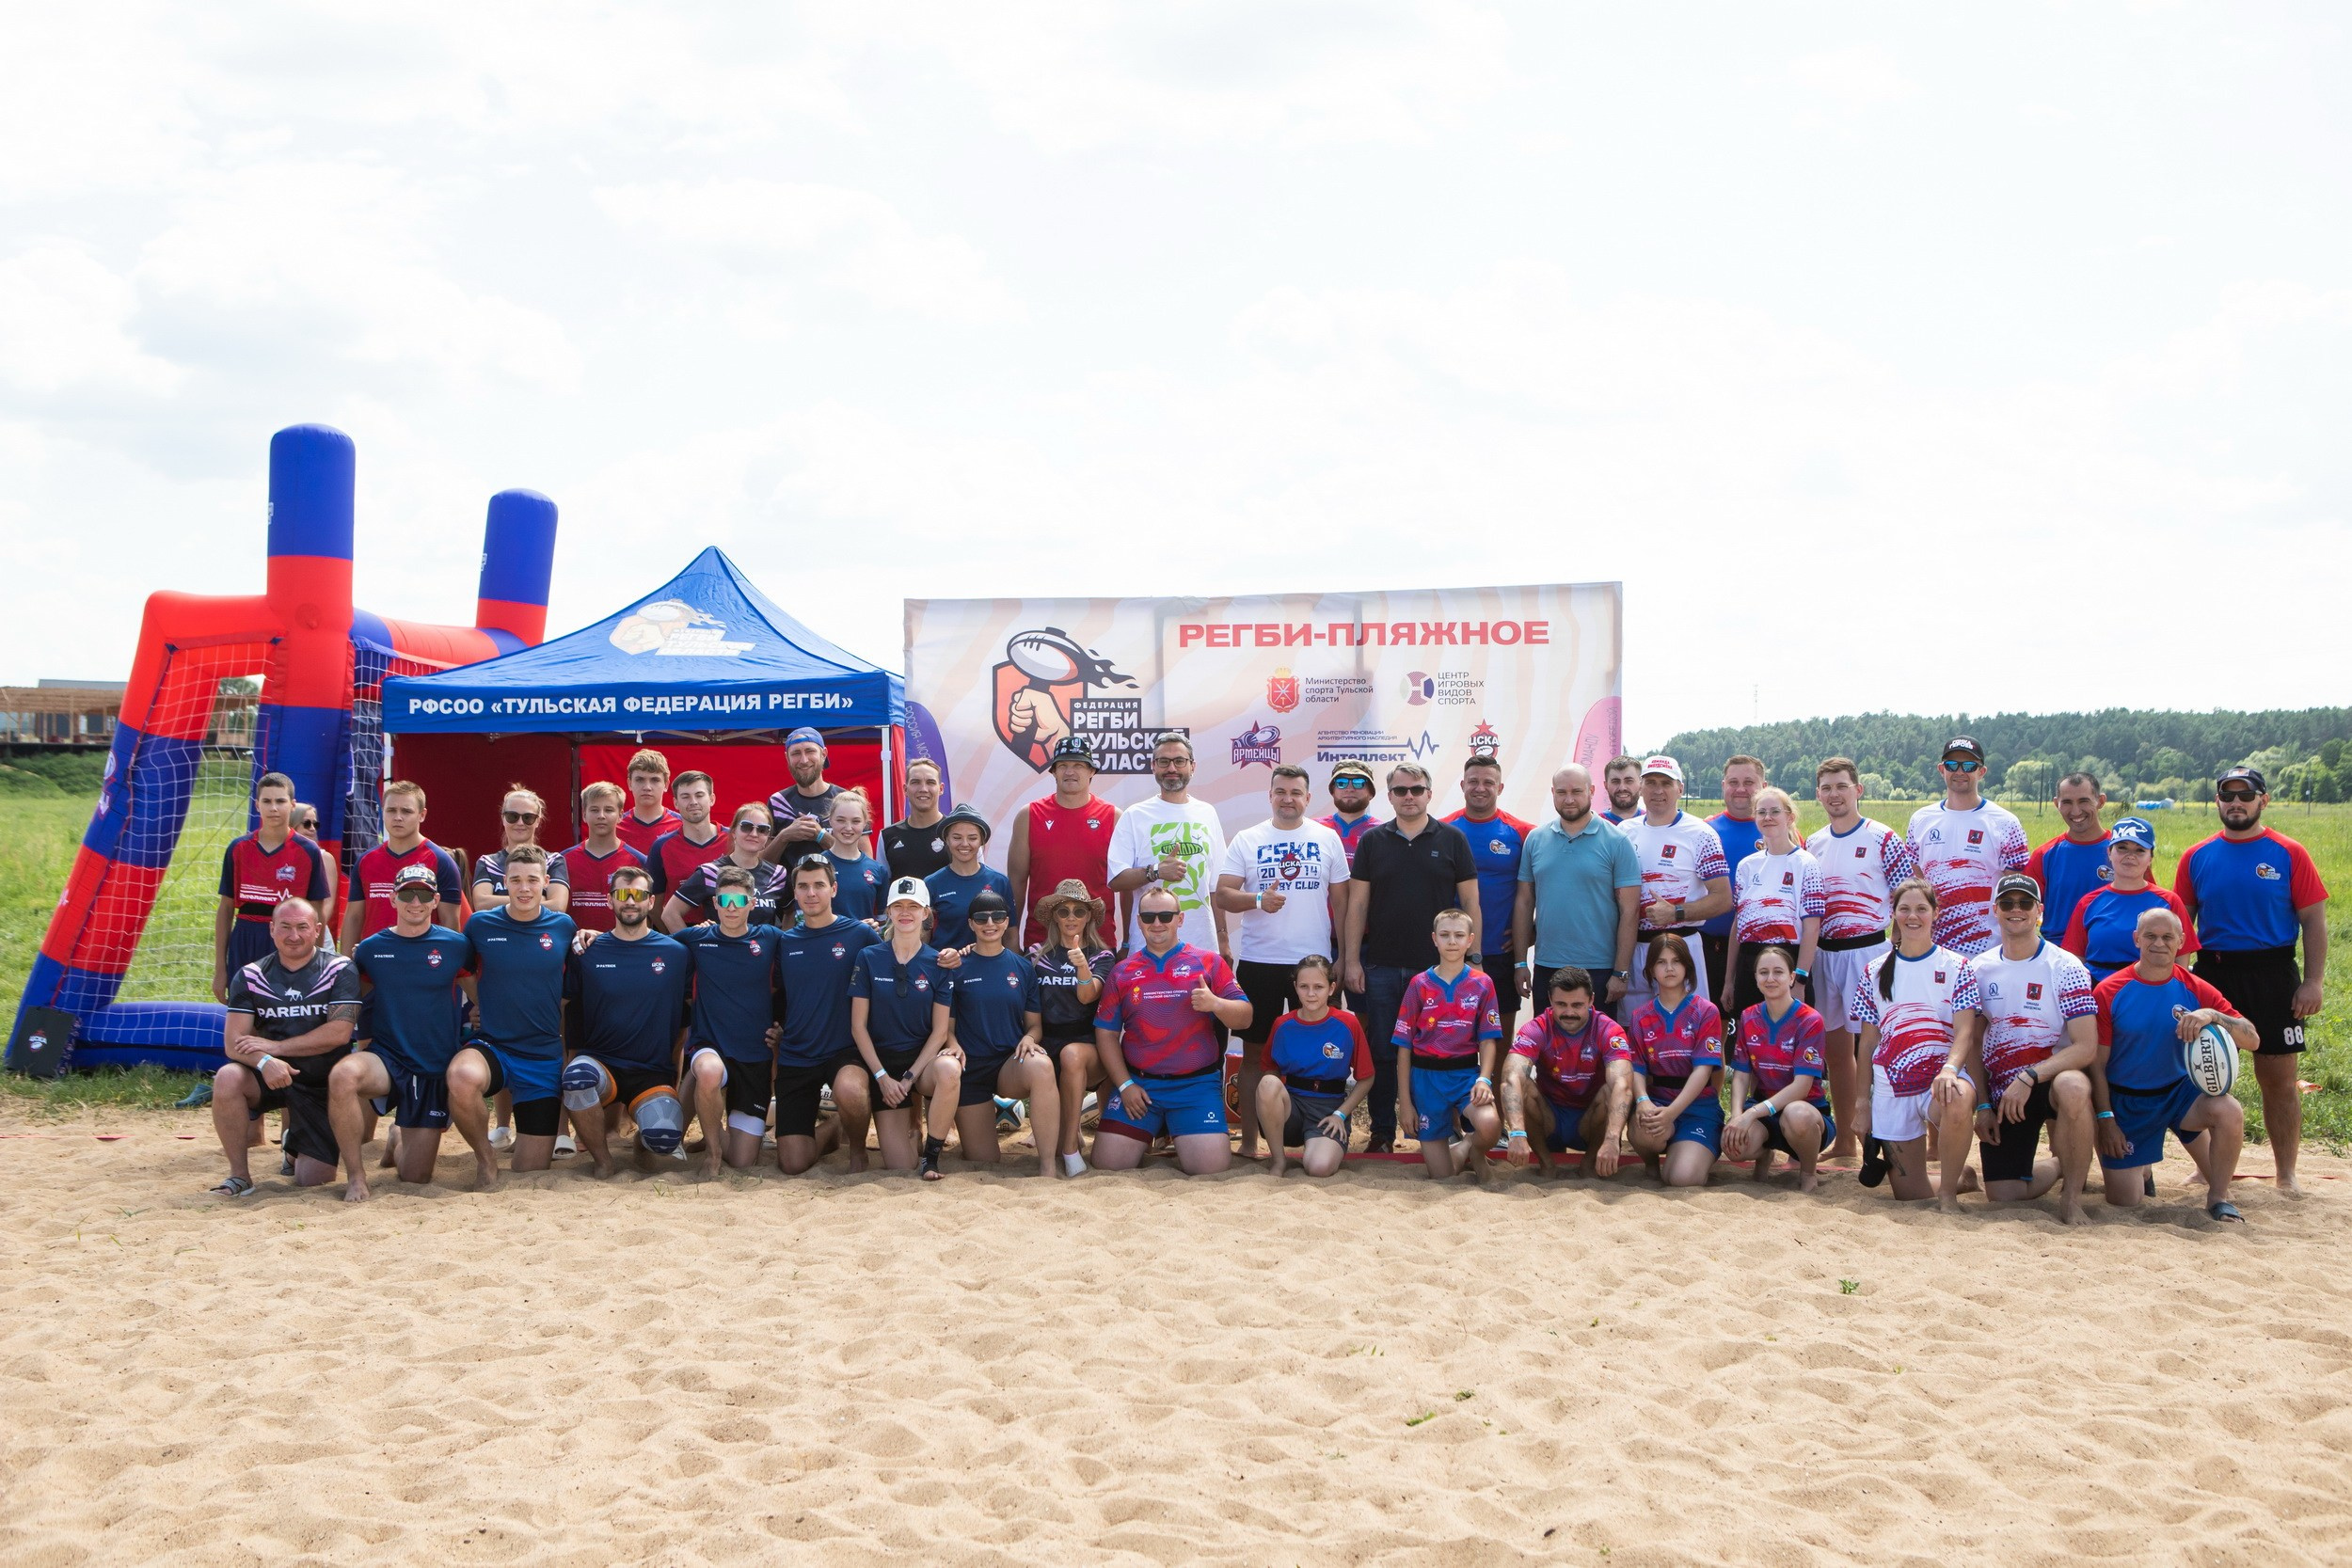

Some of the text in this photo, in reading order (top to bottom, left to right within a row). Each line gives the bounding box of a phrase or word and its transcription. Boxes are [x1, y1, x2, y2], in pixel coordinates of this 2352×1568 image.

[1179, 621, 1549, 648] РЕГБИ-ПЛЯЖНОЕ
[1305, 677, 1367, 686] Министерство
[1438, 672, 1470, 680] ЦЕНТР
[1438, 680, 1485, 689] ИГРОВЫХ
[1305, 686, 1374, 696] спорта Тульской
[408, 692, 853, 716] РФСОО «ТУЛЬСКАЯ ФЕДЕРАЦИЯ РЕГБИ»
[1305, 695, 1340, 704] области
[1073, 712, 1138, 729] РЕГБИ
[1468, 735, 1500, 746] ЦСКА
[1233, 747, 1279, 762] АРМЕЙЦЫ
[1317, 752, 1406, 762] Интеллект
[1257, 842, 1322, 864] CSKA
[1279, 861, 1302, 869] ЦСКА
[1261, 865, 1318, 879] 20 14
[1295, 881, 1320, 890] CLUB
[257, 1004, 328, 1018] PARENTS
[2283, 1025, 2304, 1046] 88
[2200, 1037, 2218, 1093] GILBERT
